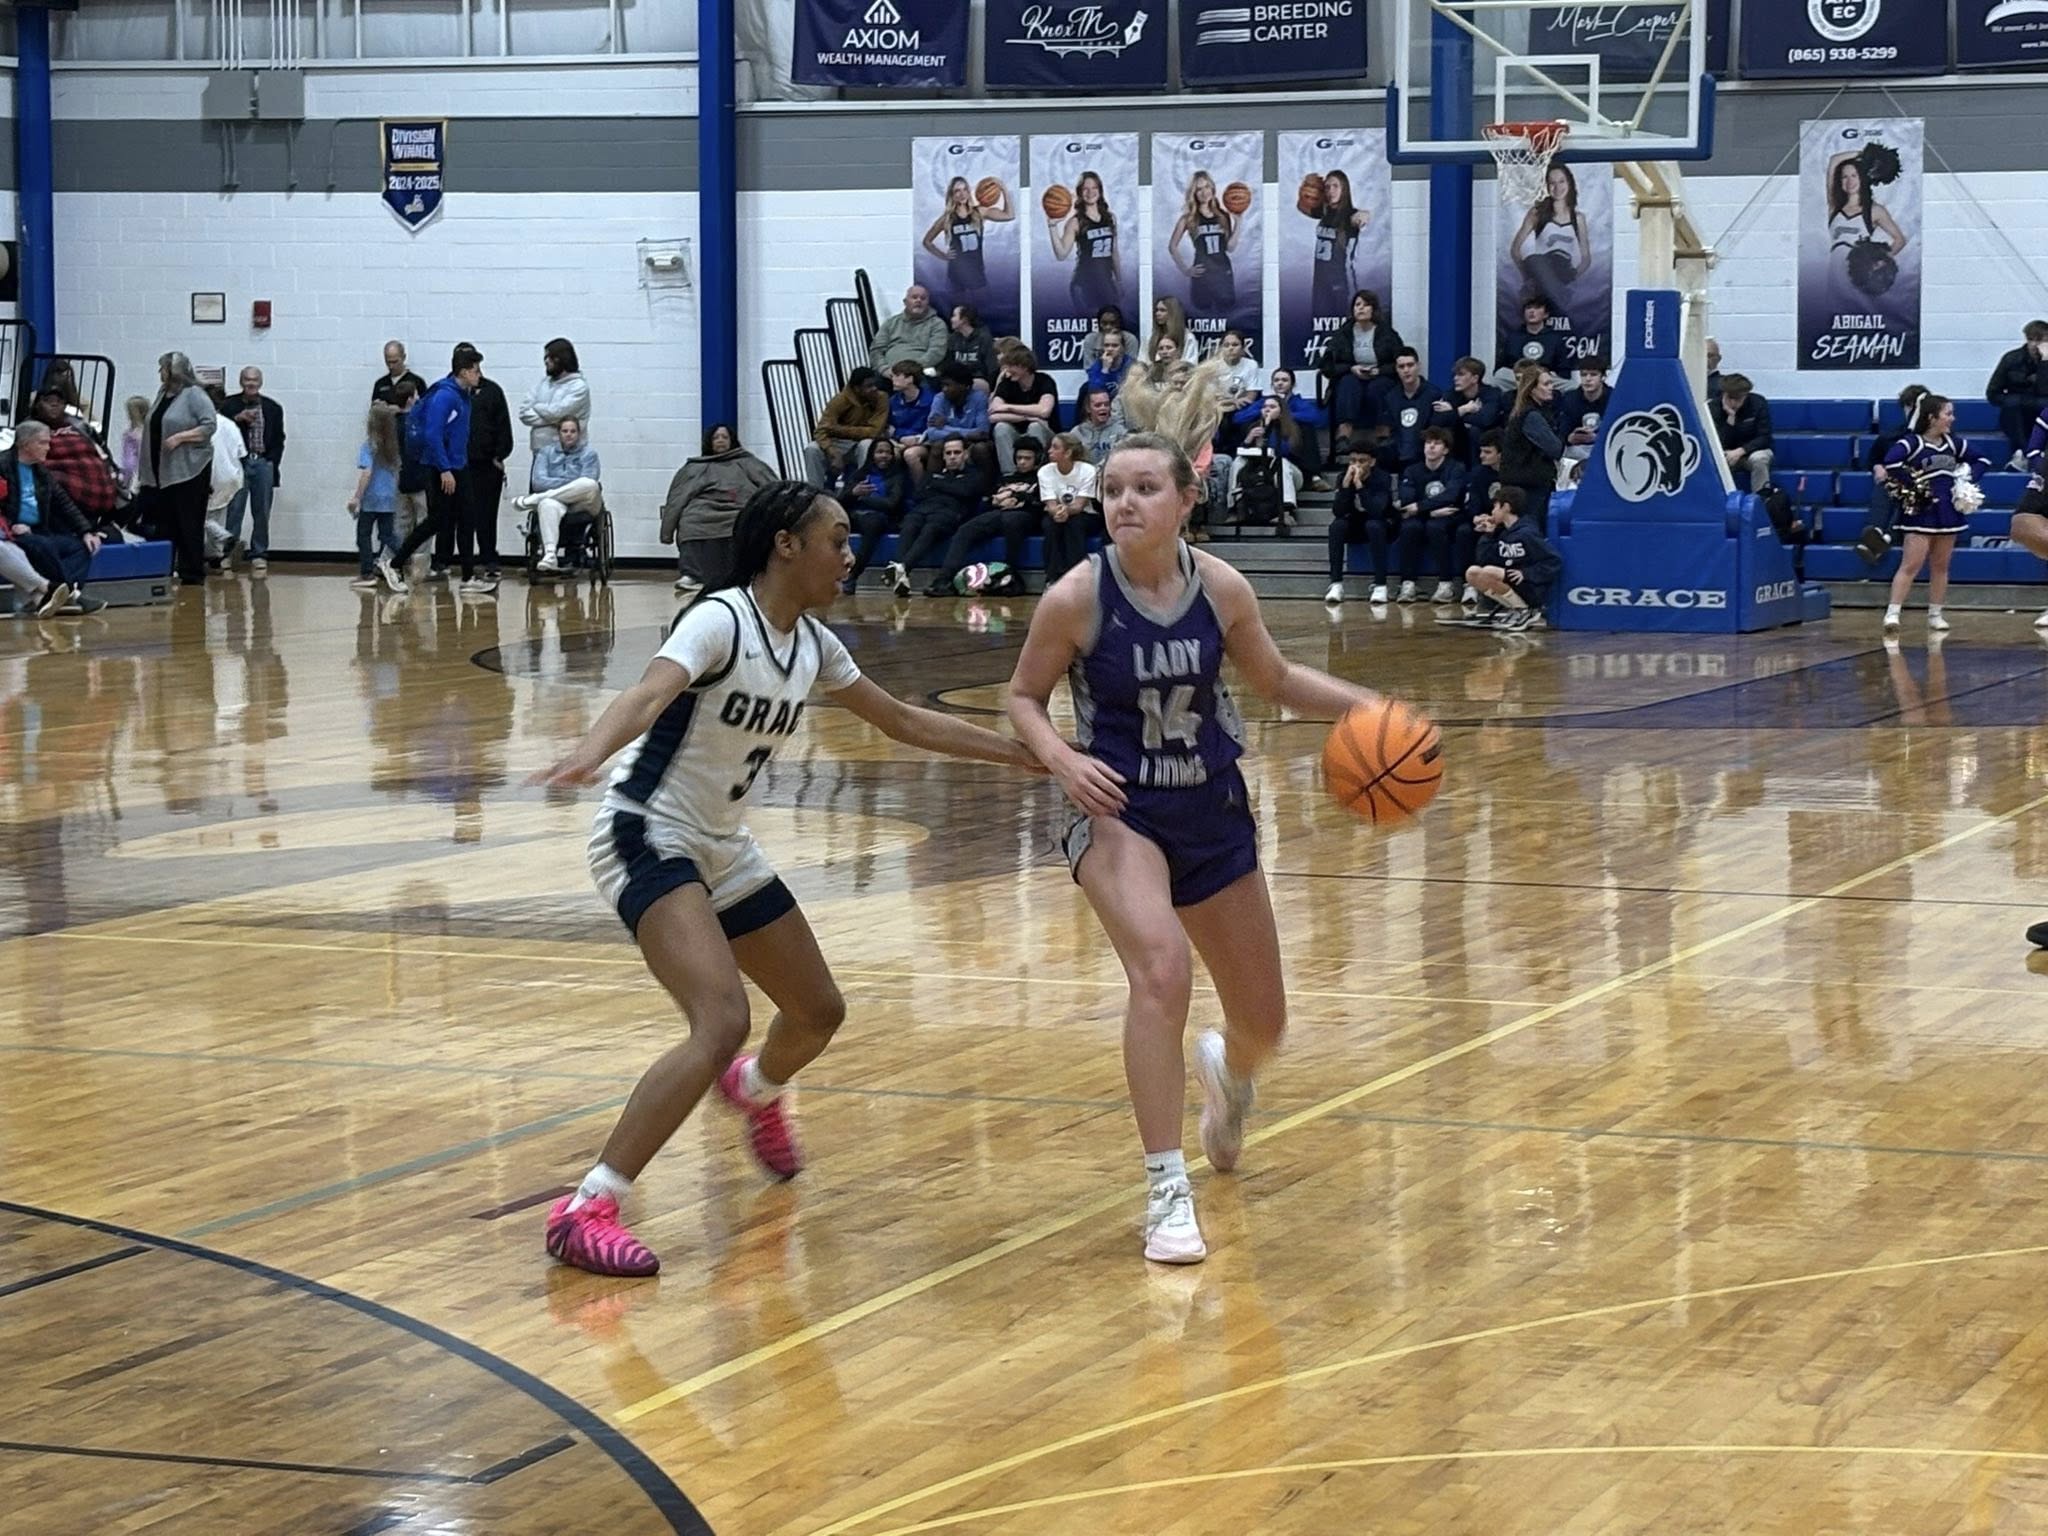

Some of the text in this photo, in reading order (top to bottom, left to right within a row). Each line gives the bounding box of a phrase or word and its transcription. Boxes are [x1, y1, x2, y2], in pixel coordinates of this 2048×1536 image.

[1254, 1, 1352, 21] BREEDING
[842, 28, 920, 50] AXIOM
[1254, 22, 1328, 42] CARTER
[817, 53, 946, 67] WEALTH MANAGEMENT
[1788, 47, 1898, 63] (865) 938-5299
[392, 128, 436, 144] DIVISION
[392, 143, 436, 160] WINNER
[389, 175, 440, 190] 2024-2025
[1047, 318, 1088, 333] SARAH
[1187, 318, 1227, 332] LOGAN
[1831, 314, 1886, 329] ABIGAIL
[1562, 333, 1601, 359] SON
[1811, 332, 1906, 363] SEAMAN
[1567, 587, 1727, 608] GRACE
[1755, 580, 1795, 604] GRACE
[1132, 638, 1201, 682] LADY
[720, 689, 805, 736] GRAC
[1137, 684, 1203, 750] 14
[728, 745, 773, 803] 3
